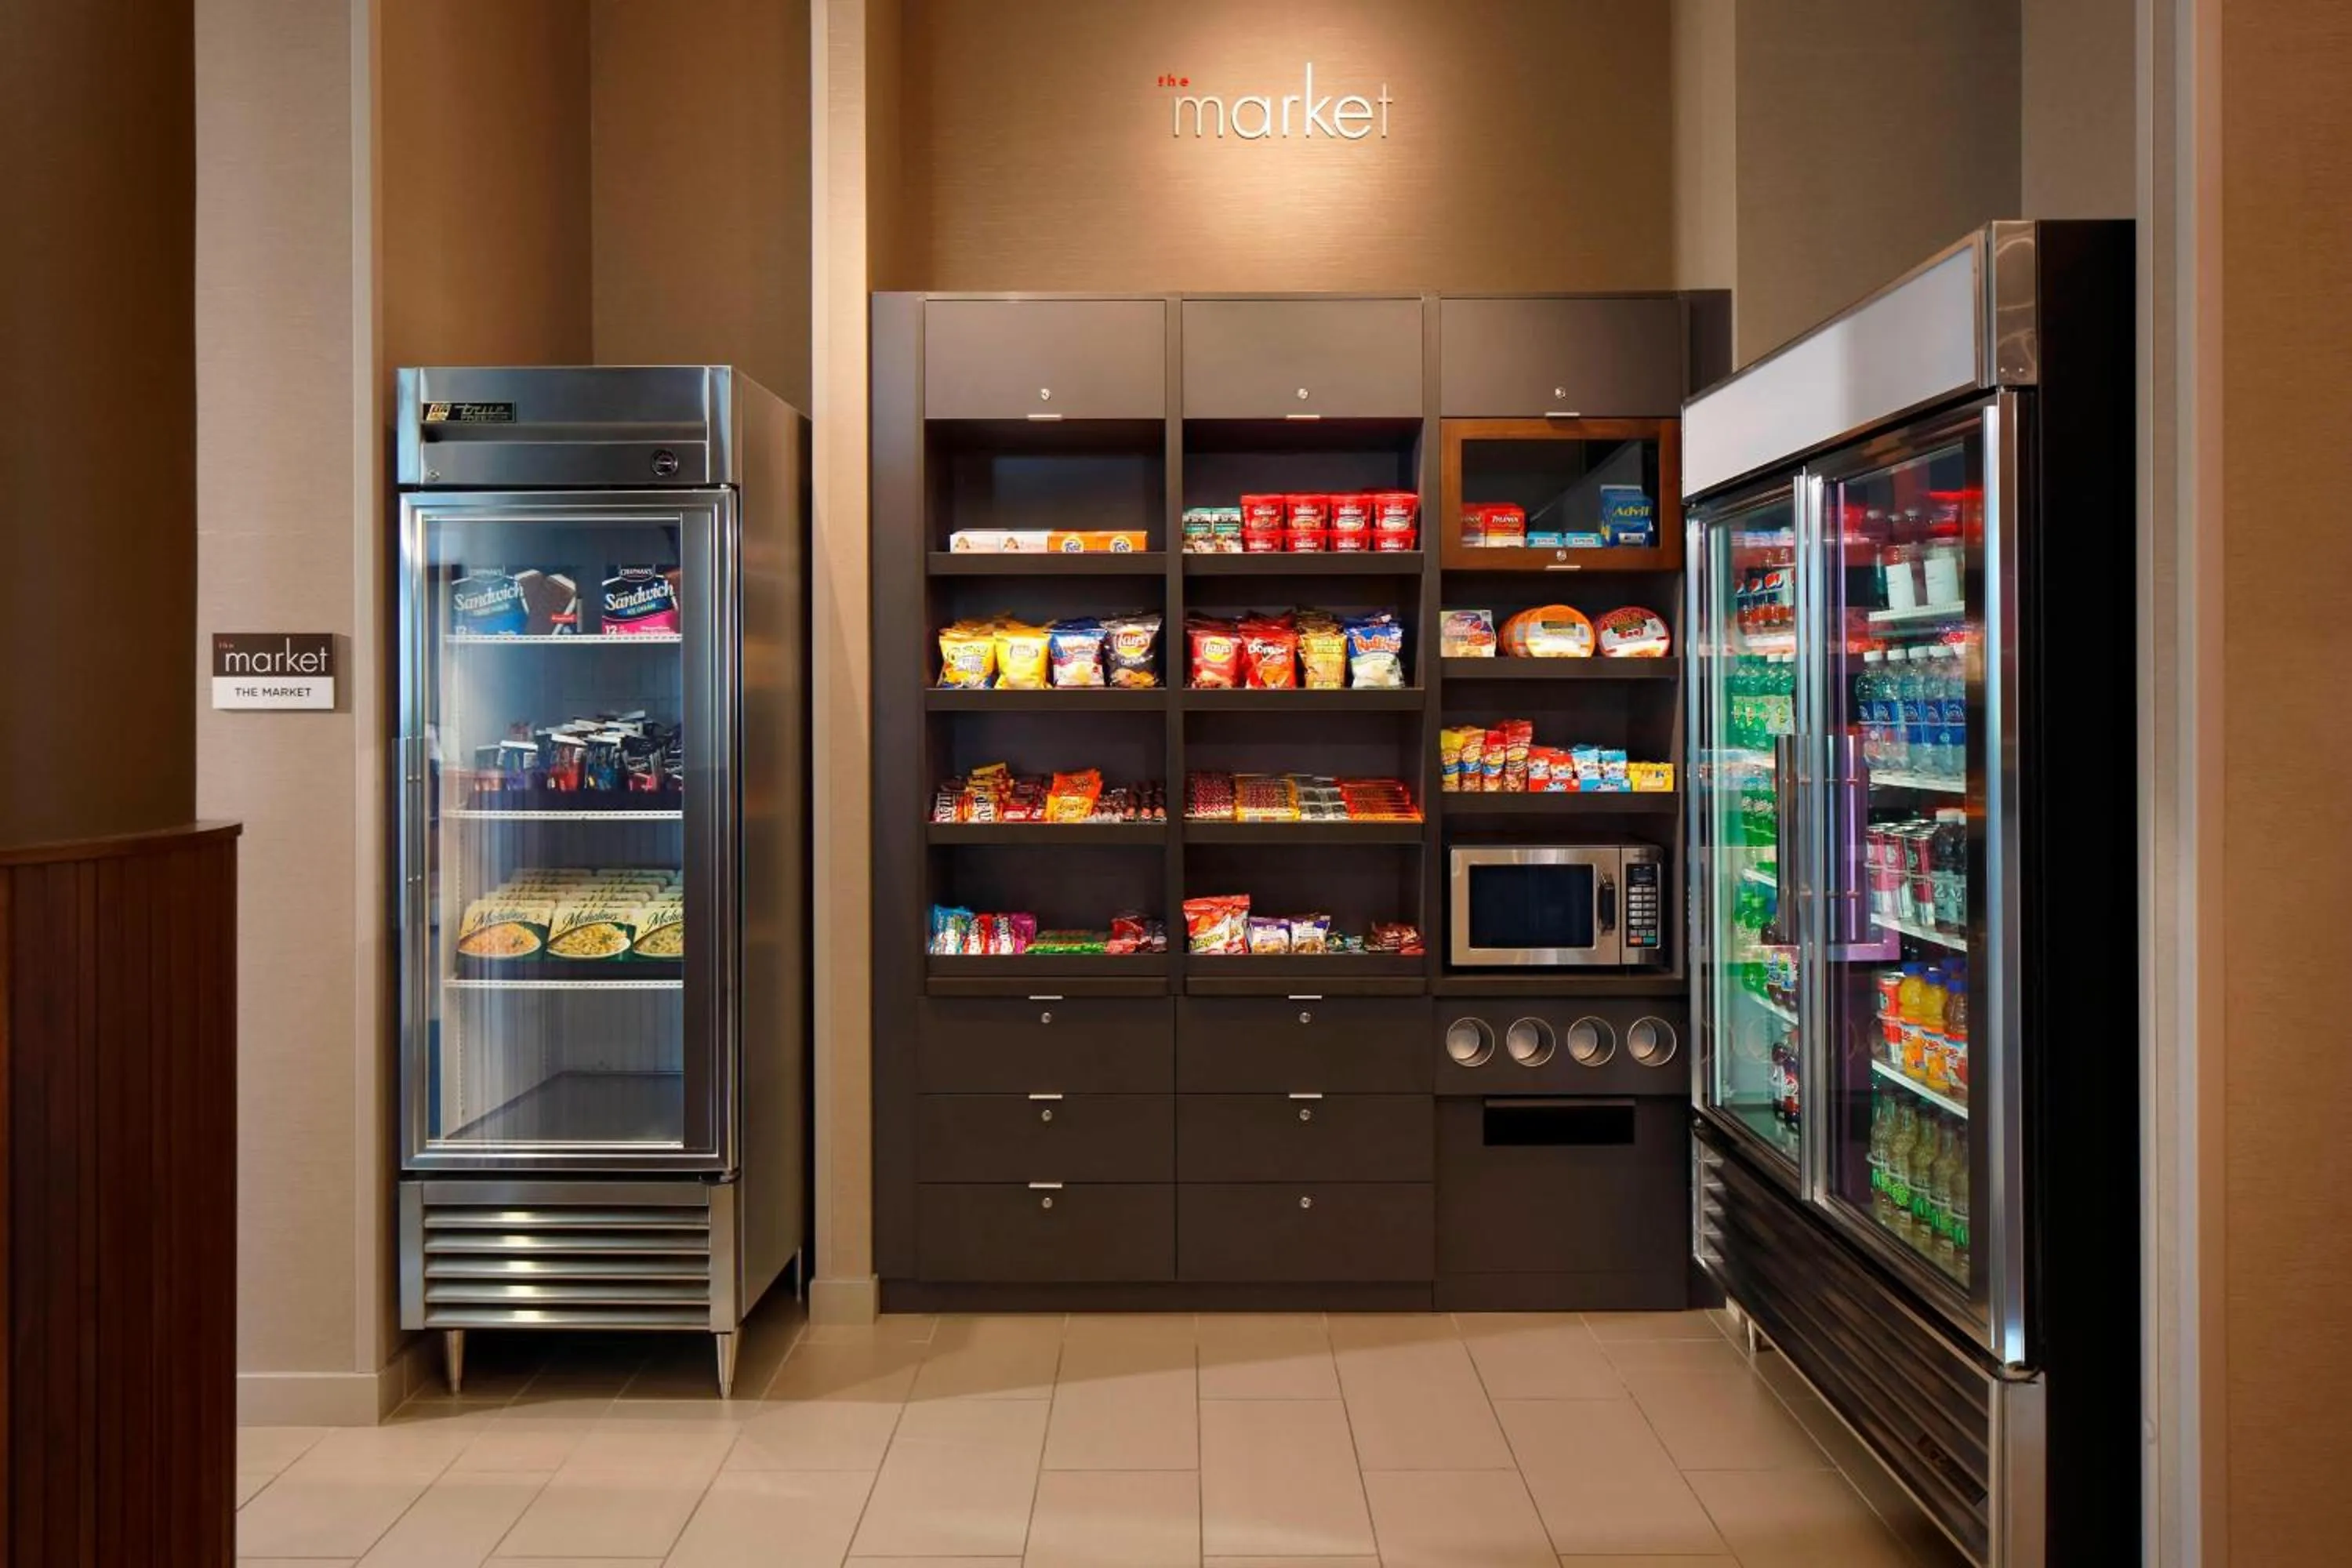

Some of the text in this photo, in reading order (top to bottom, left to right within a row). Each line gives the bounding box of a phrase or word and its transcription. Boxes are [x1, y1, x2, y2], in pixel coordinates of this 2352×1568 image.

[1156, 74, 1190, 87] the
[1173, 62, 1394, 140] market
[1614, 506, 1650, 517] Advil
[455, 581, 524, 611] Sandwich
[604, 579, 675, 611] Sandwich
[224, 637, 329, 673] market
[234, 688, 312, 697] THE MARKET
